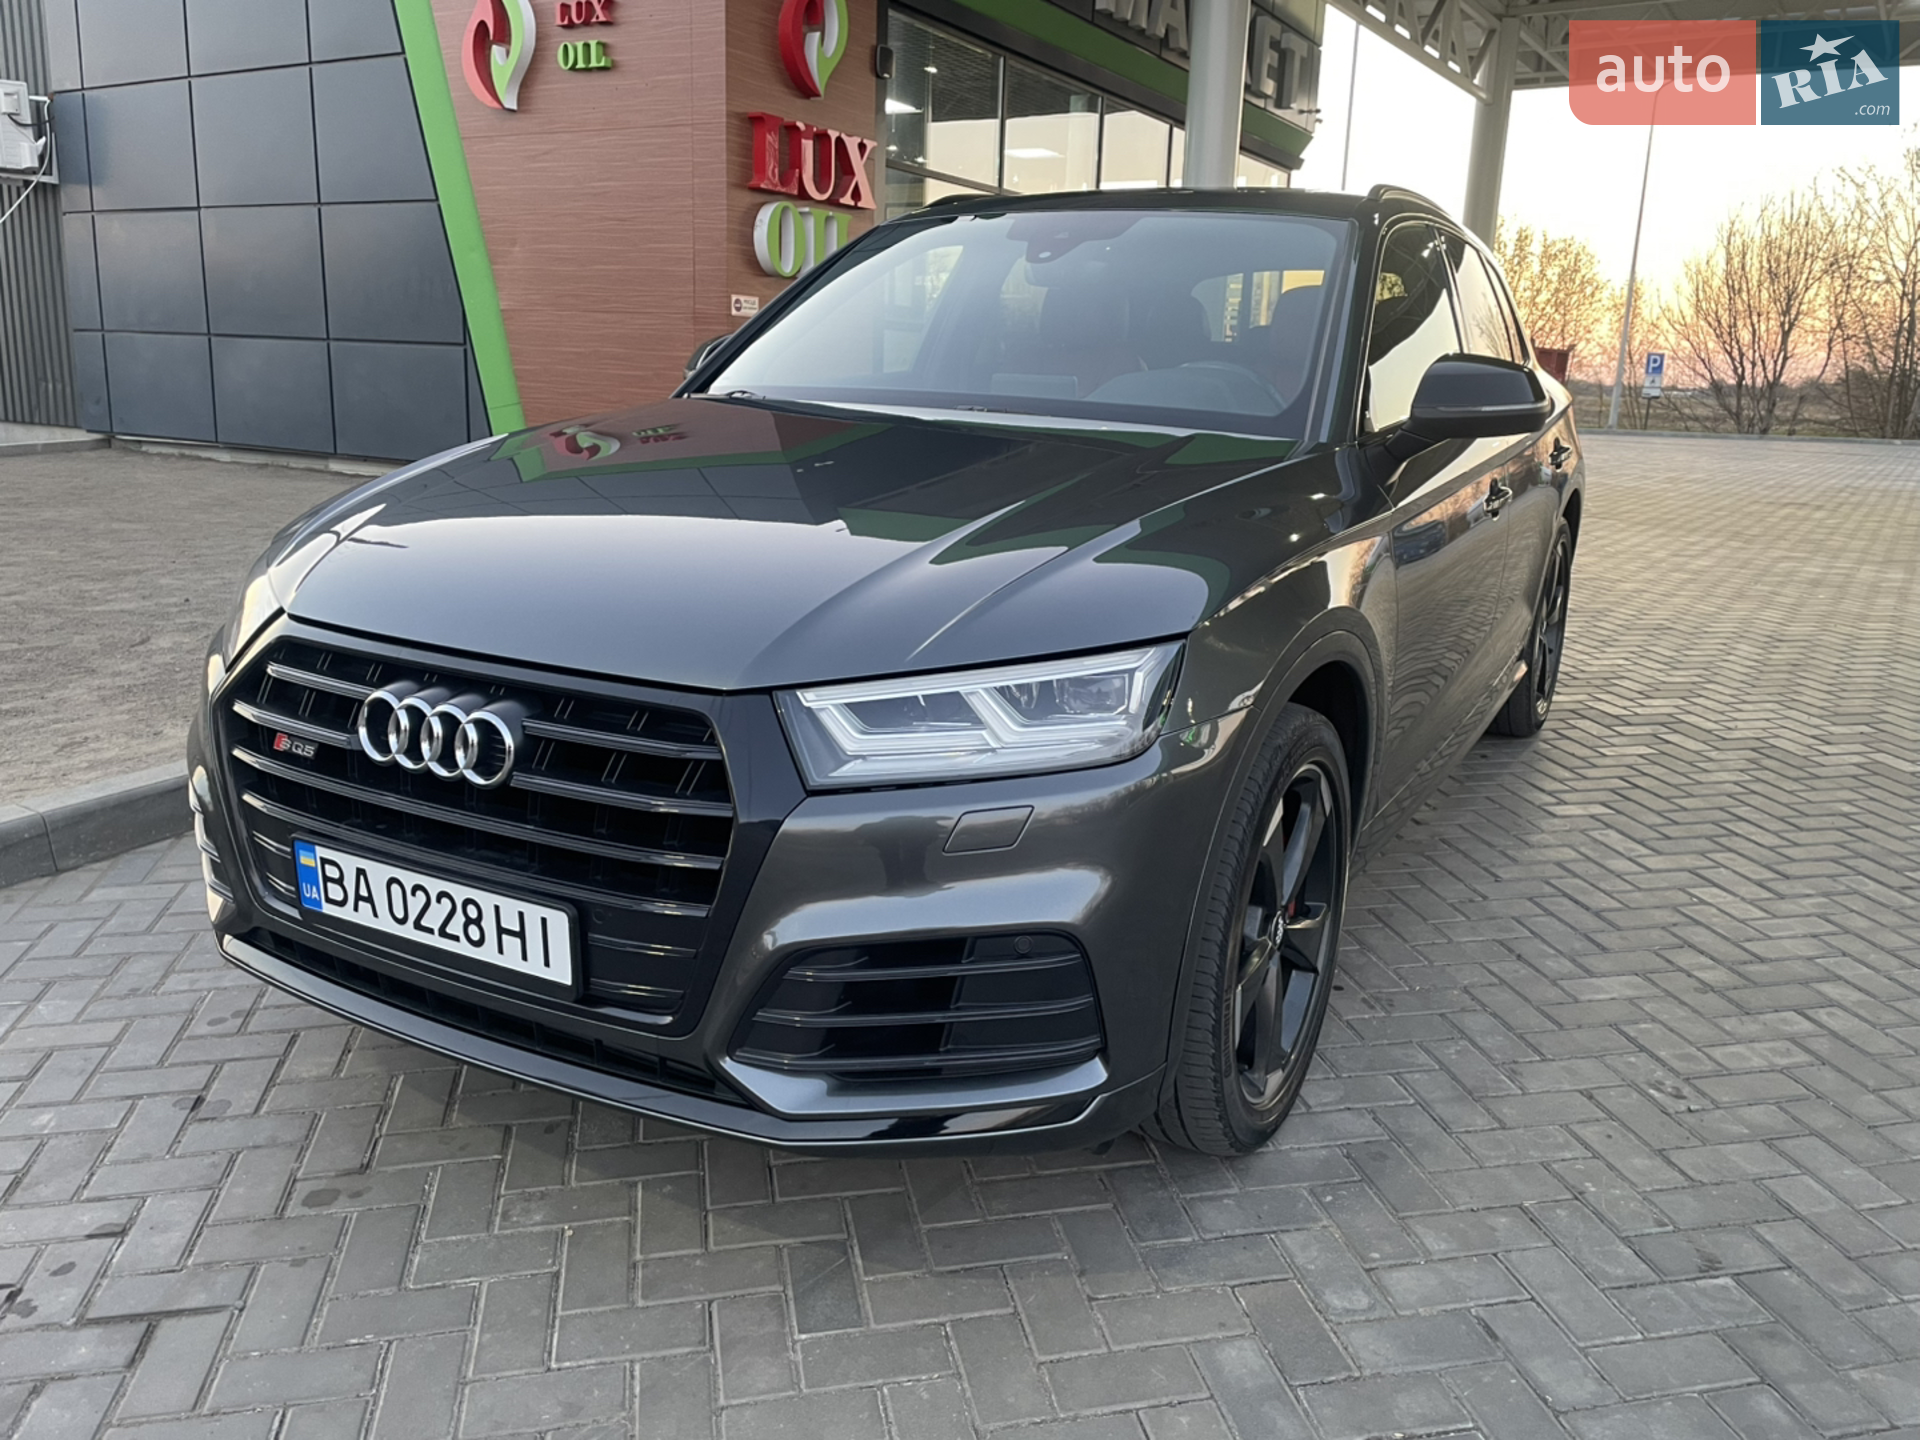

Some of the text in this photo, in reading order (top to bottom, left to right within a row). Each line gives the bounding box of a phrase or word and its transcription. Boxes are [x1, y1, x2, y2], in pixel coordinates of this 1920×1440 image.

[555, 0, 613, 26] LUX
[557, 40, 612, 70] OIL
[748, 112, 877, 210] LUX
[1648, 355, 1661, 373] P
[273, 732, 315, 757] SQ5
[302, 882, 320, 901] UA
